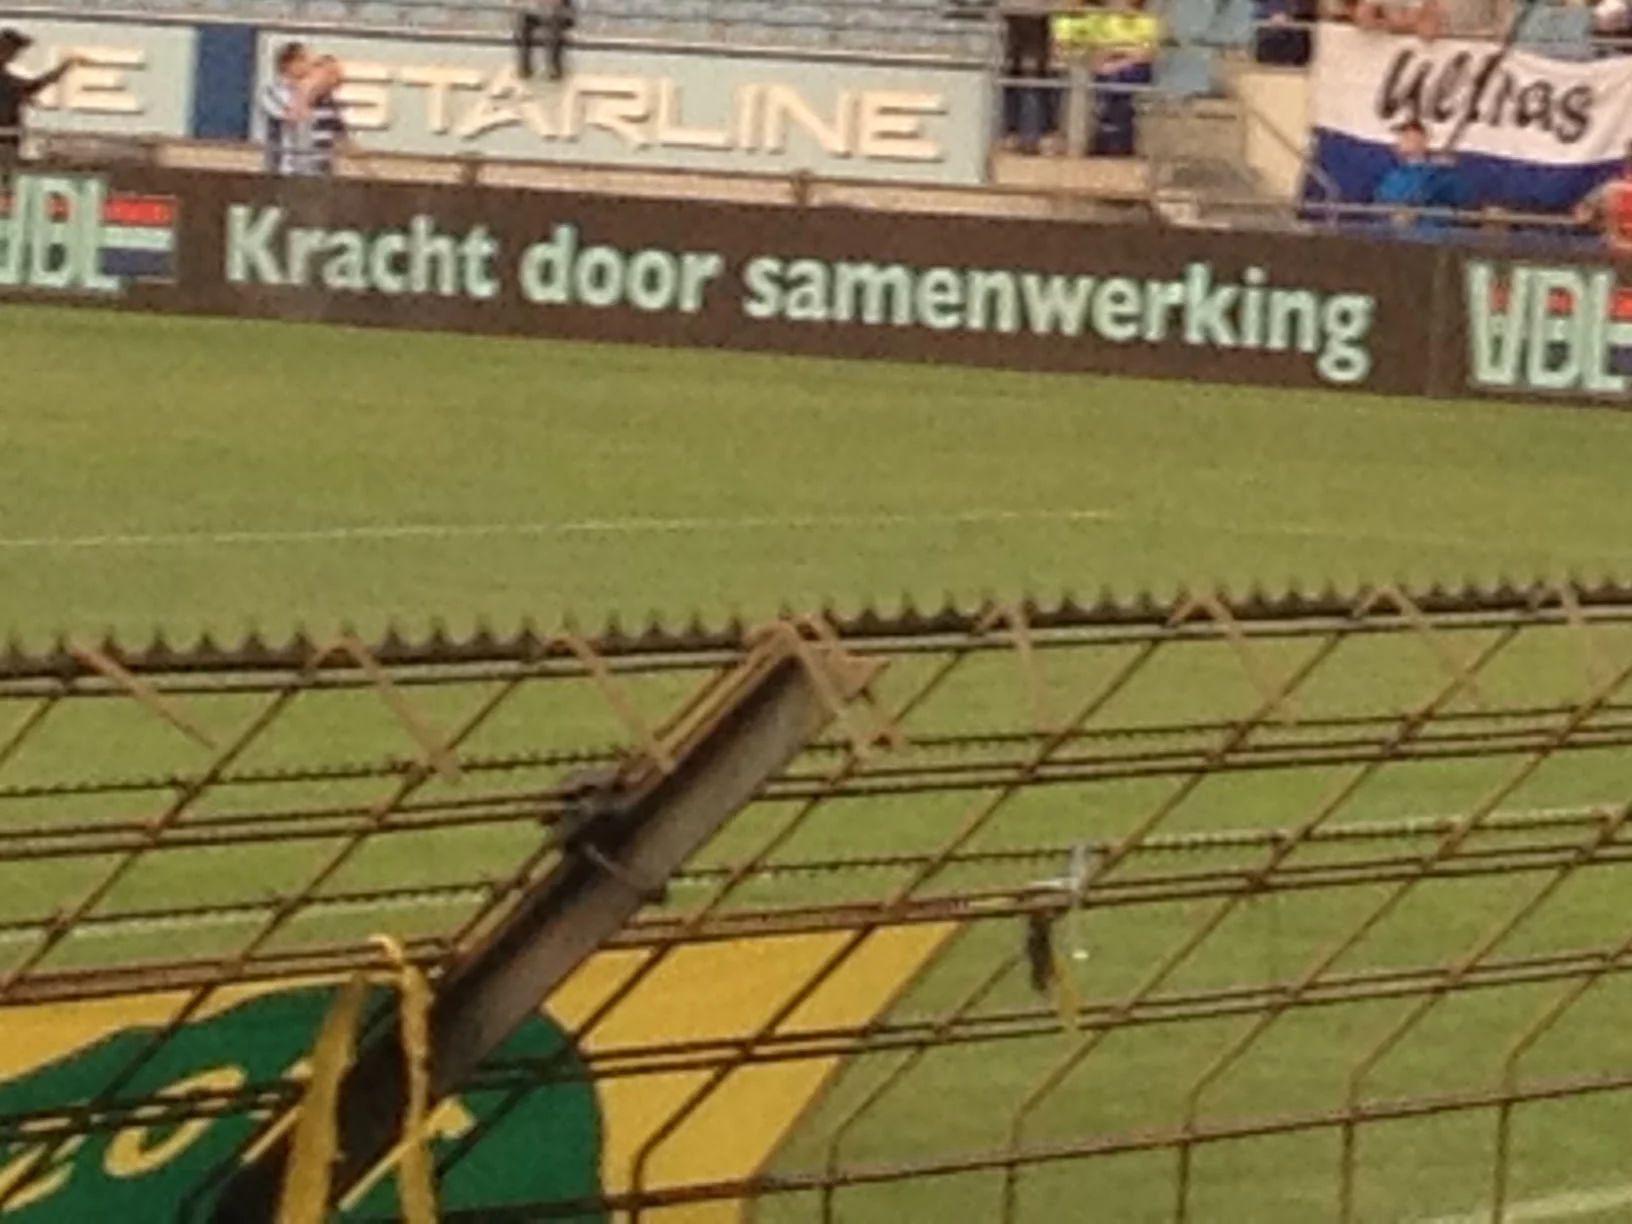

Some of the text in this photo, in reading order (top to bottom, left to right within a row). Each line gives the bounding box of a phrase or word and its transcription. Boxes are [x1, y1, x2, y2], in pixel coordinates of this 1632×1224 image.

[225, 203, 499, 299] Kracht
[519, 222, 721, 313] door
[742, 254, 1375, 381] samenwerking
[1466, 262, 1632, 392] VDL
